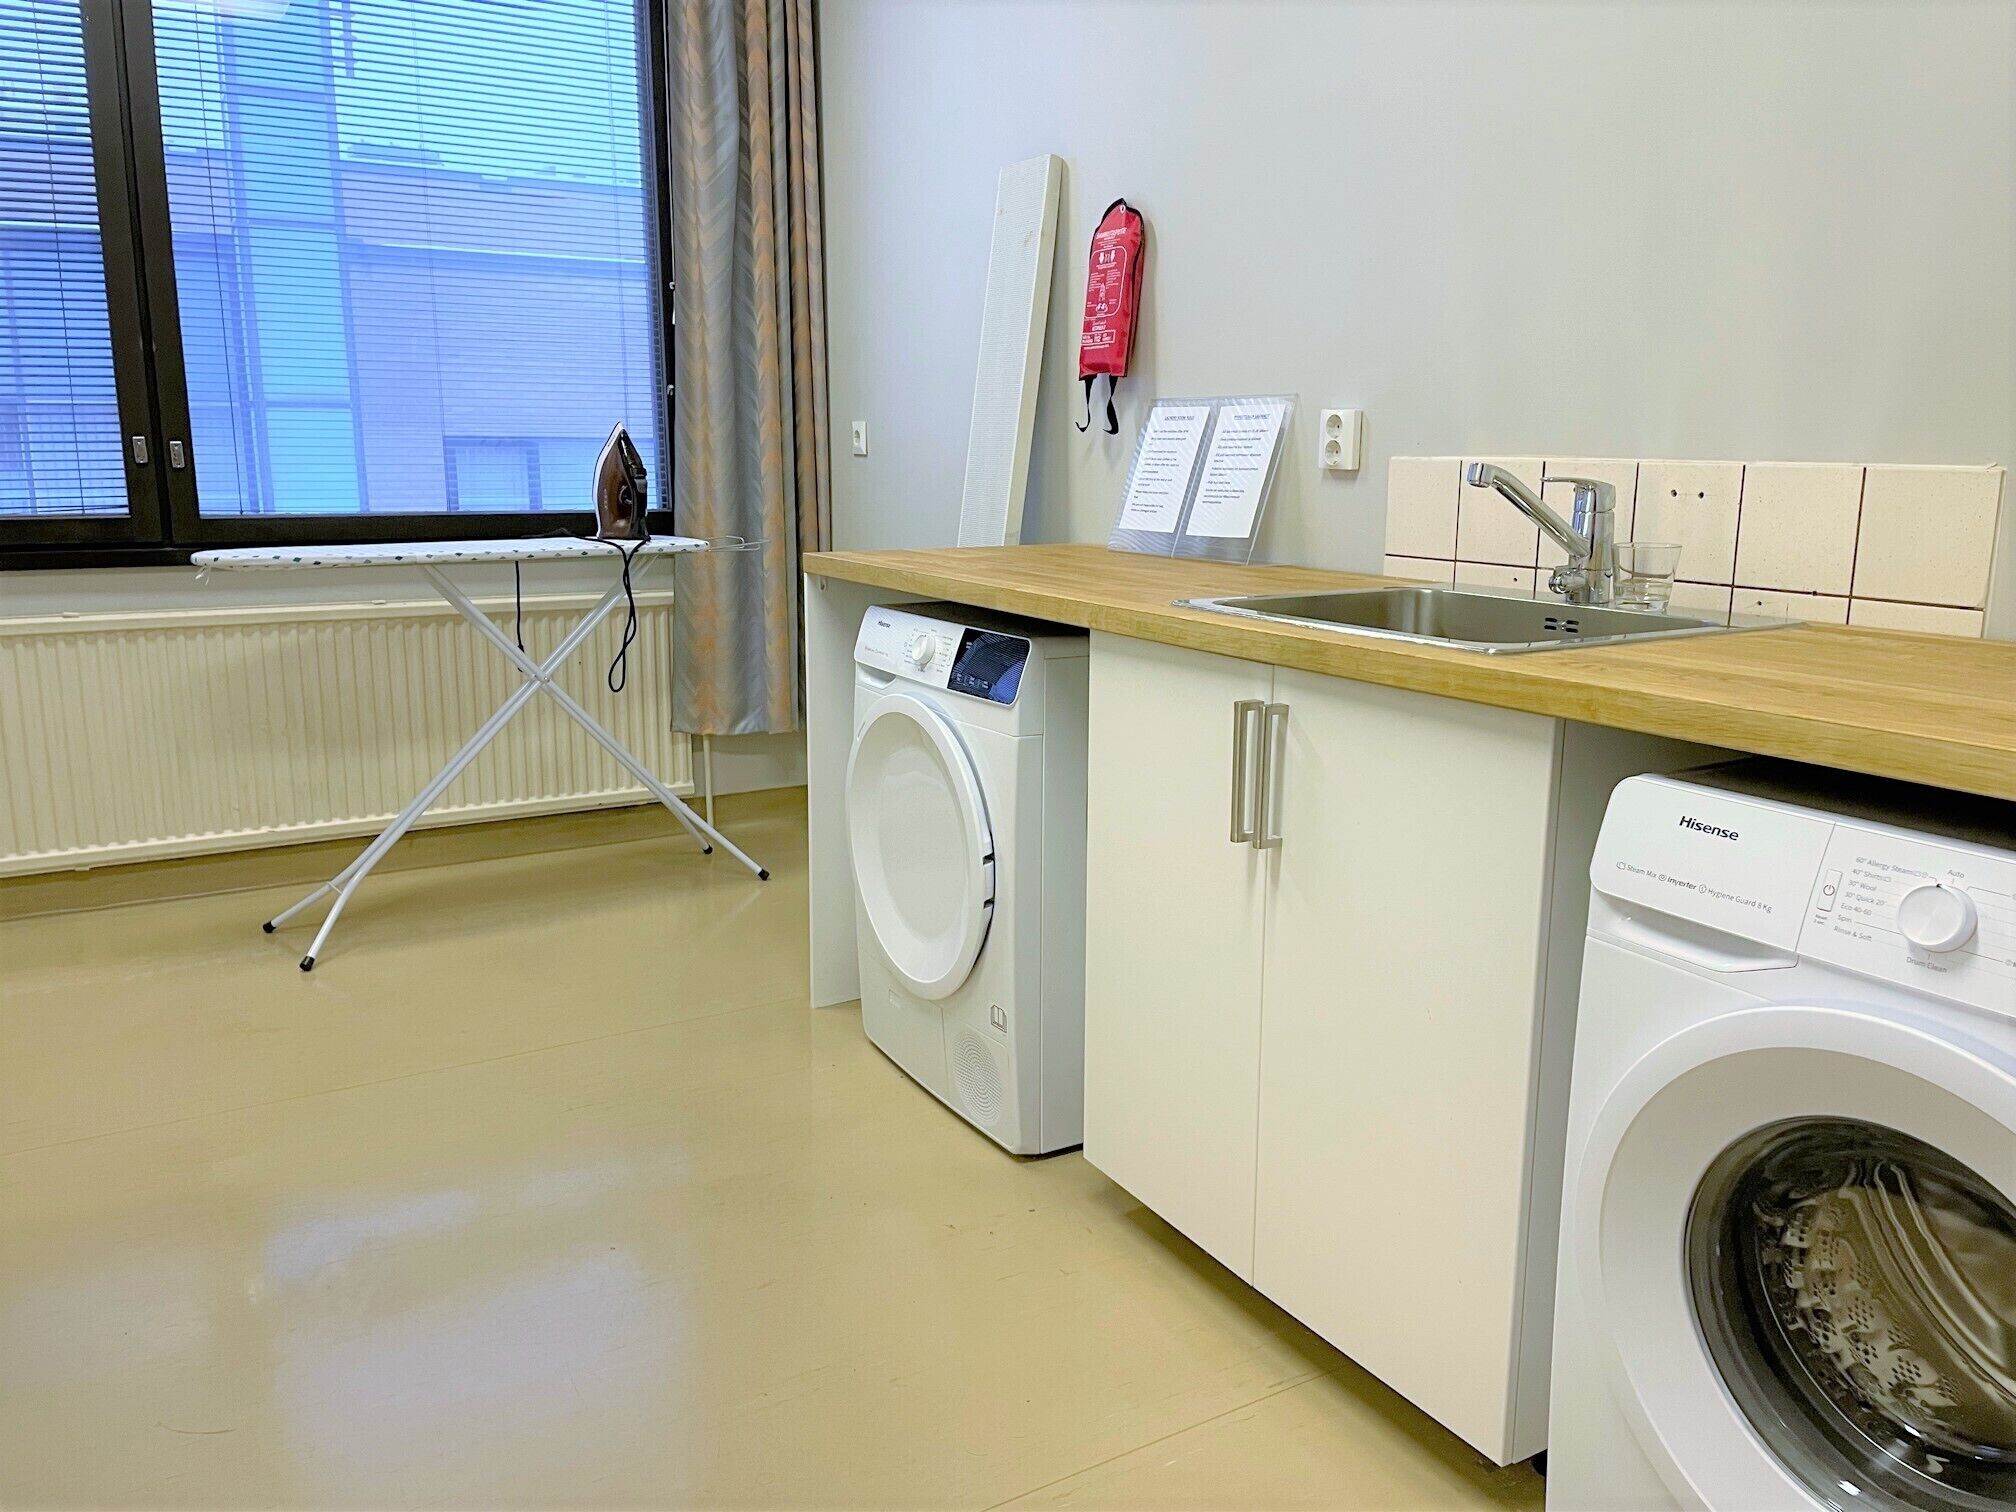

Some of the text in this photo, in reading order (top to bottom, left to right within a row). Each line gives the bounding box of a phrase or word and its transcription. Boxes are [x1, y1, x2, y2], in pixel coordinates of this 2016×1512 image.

[1679, 815, 1739, 841] Hisense
[1867, 859, 1891, 871] Allergy
[1947, 869, 1965, 879] Auto
[1627, 864, 1645, 875] Steam
[1646, 870, 1657, 878] Mix
[1667, 876, 1697, 890] Inverter
[1708, 888, 1735, 902] Hygiene
[1735, 895, 1757, 908] Guard
[1762, 903, 1773, 914] Kg
[1860, 882, 1877, 892] Wool
[1840, 902, 1852, 911] Eco
[1906, 956, 1926, 967] Drum
